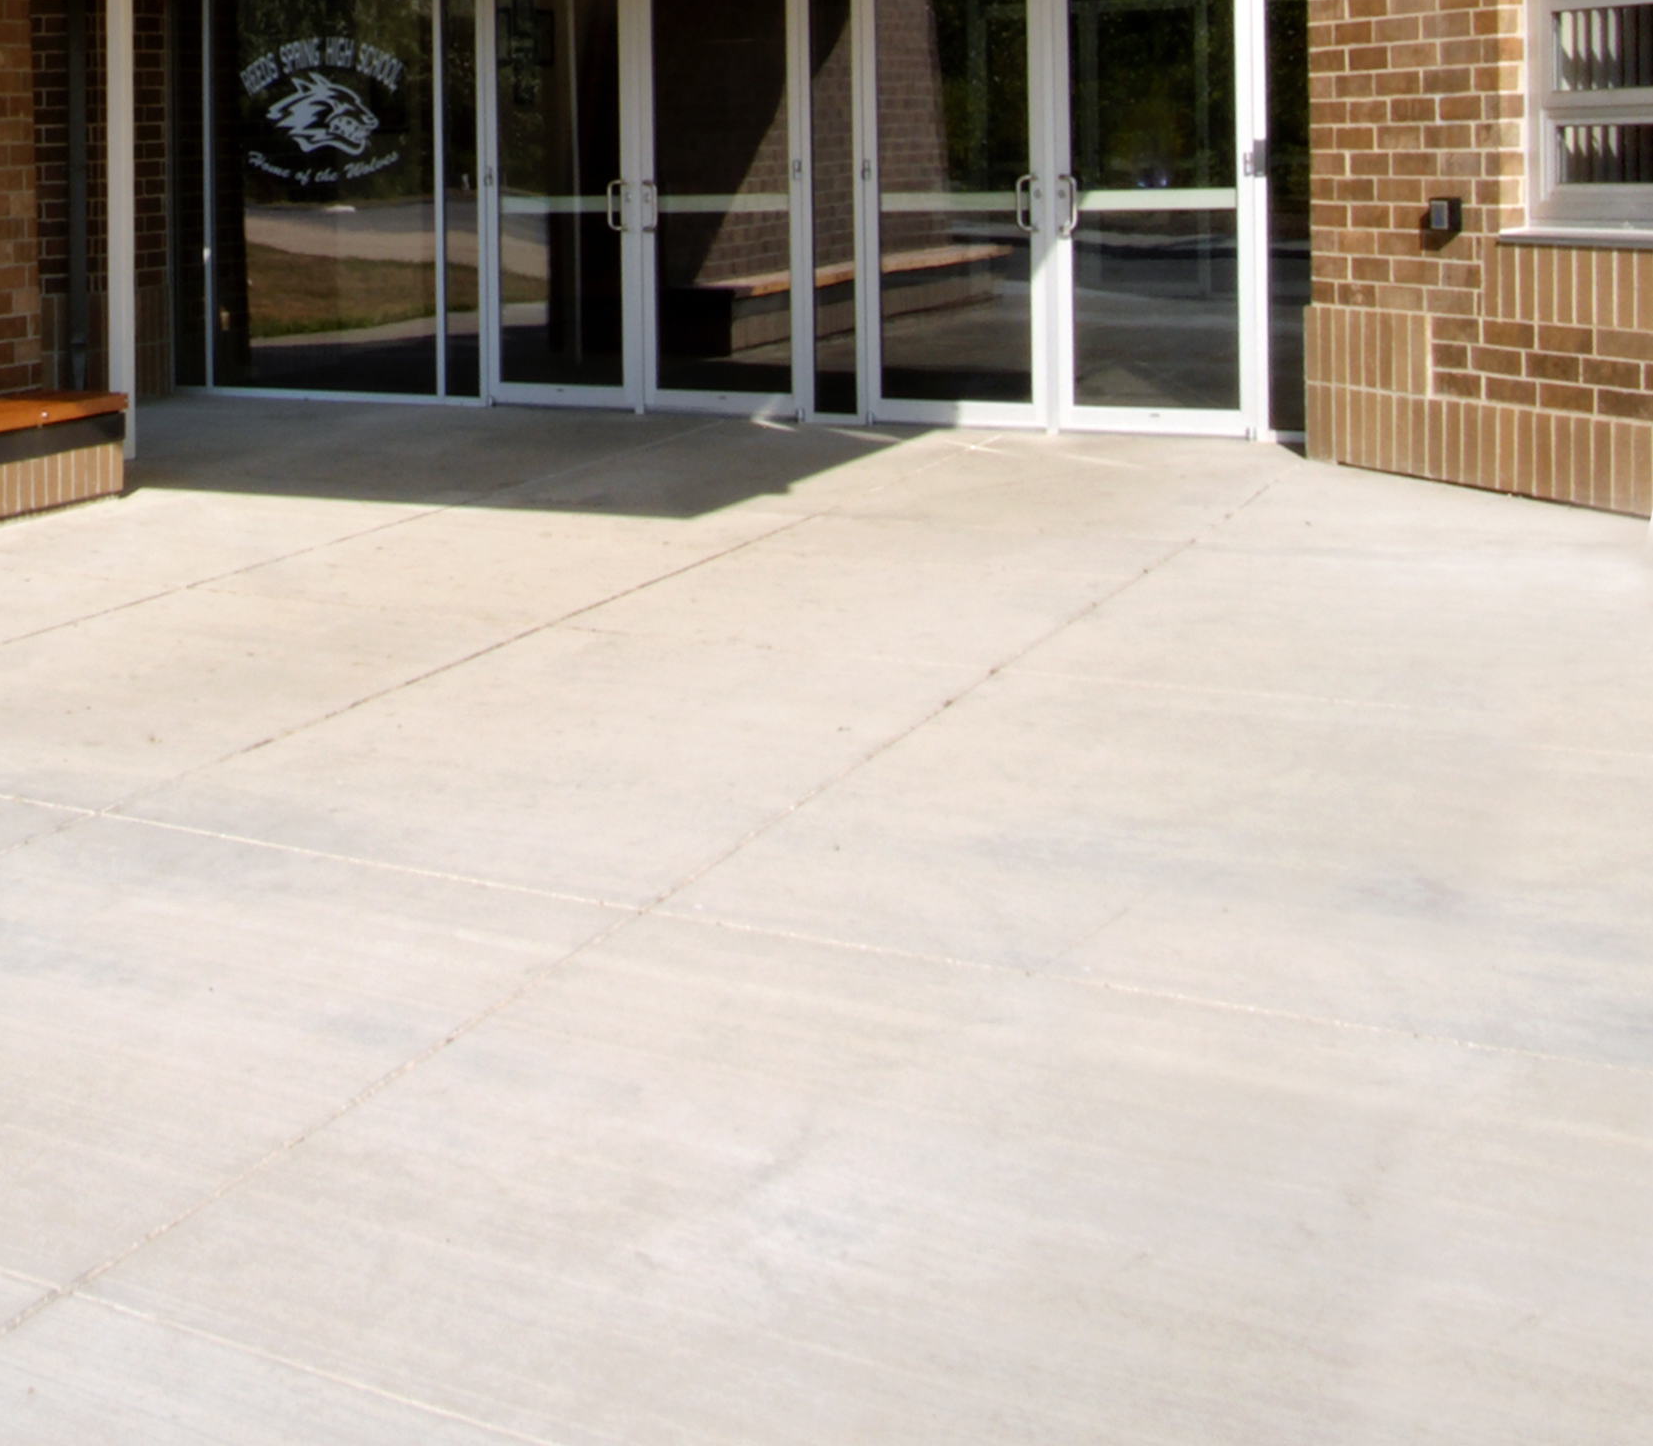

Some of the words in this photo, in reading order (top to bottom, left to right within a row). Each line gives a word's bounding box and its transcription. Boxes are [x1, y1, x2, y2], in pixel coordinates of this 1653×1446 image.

[239, 52, 279, 96] REEDS
[279, 36, 322, 74] SPRING
[325, 36, 355, 68] HIGH
[356, 42, 405, 92] SCHOOL
[248, 151, 291, 178] Home
[294, 170, 309, 185] of
[314, 167, 338, 182] the
[344, 151, 399, 179] Wolves
